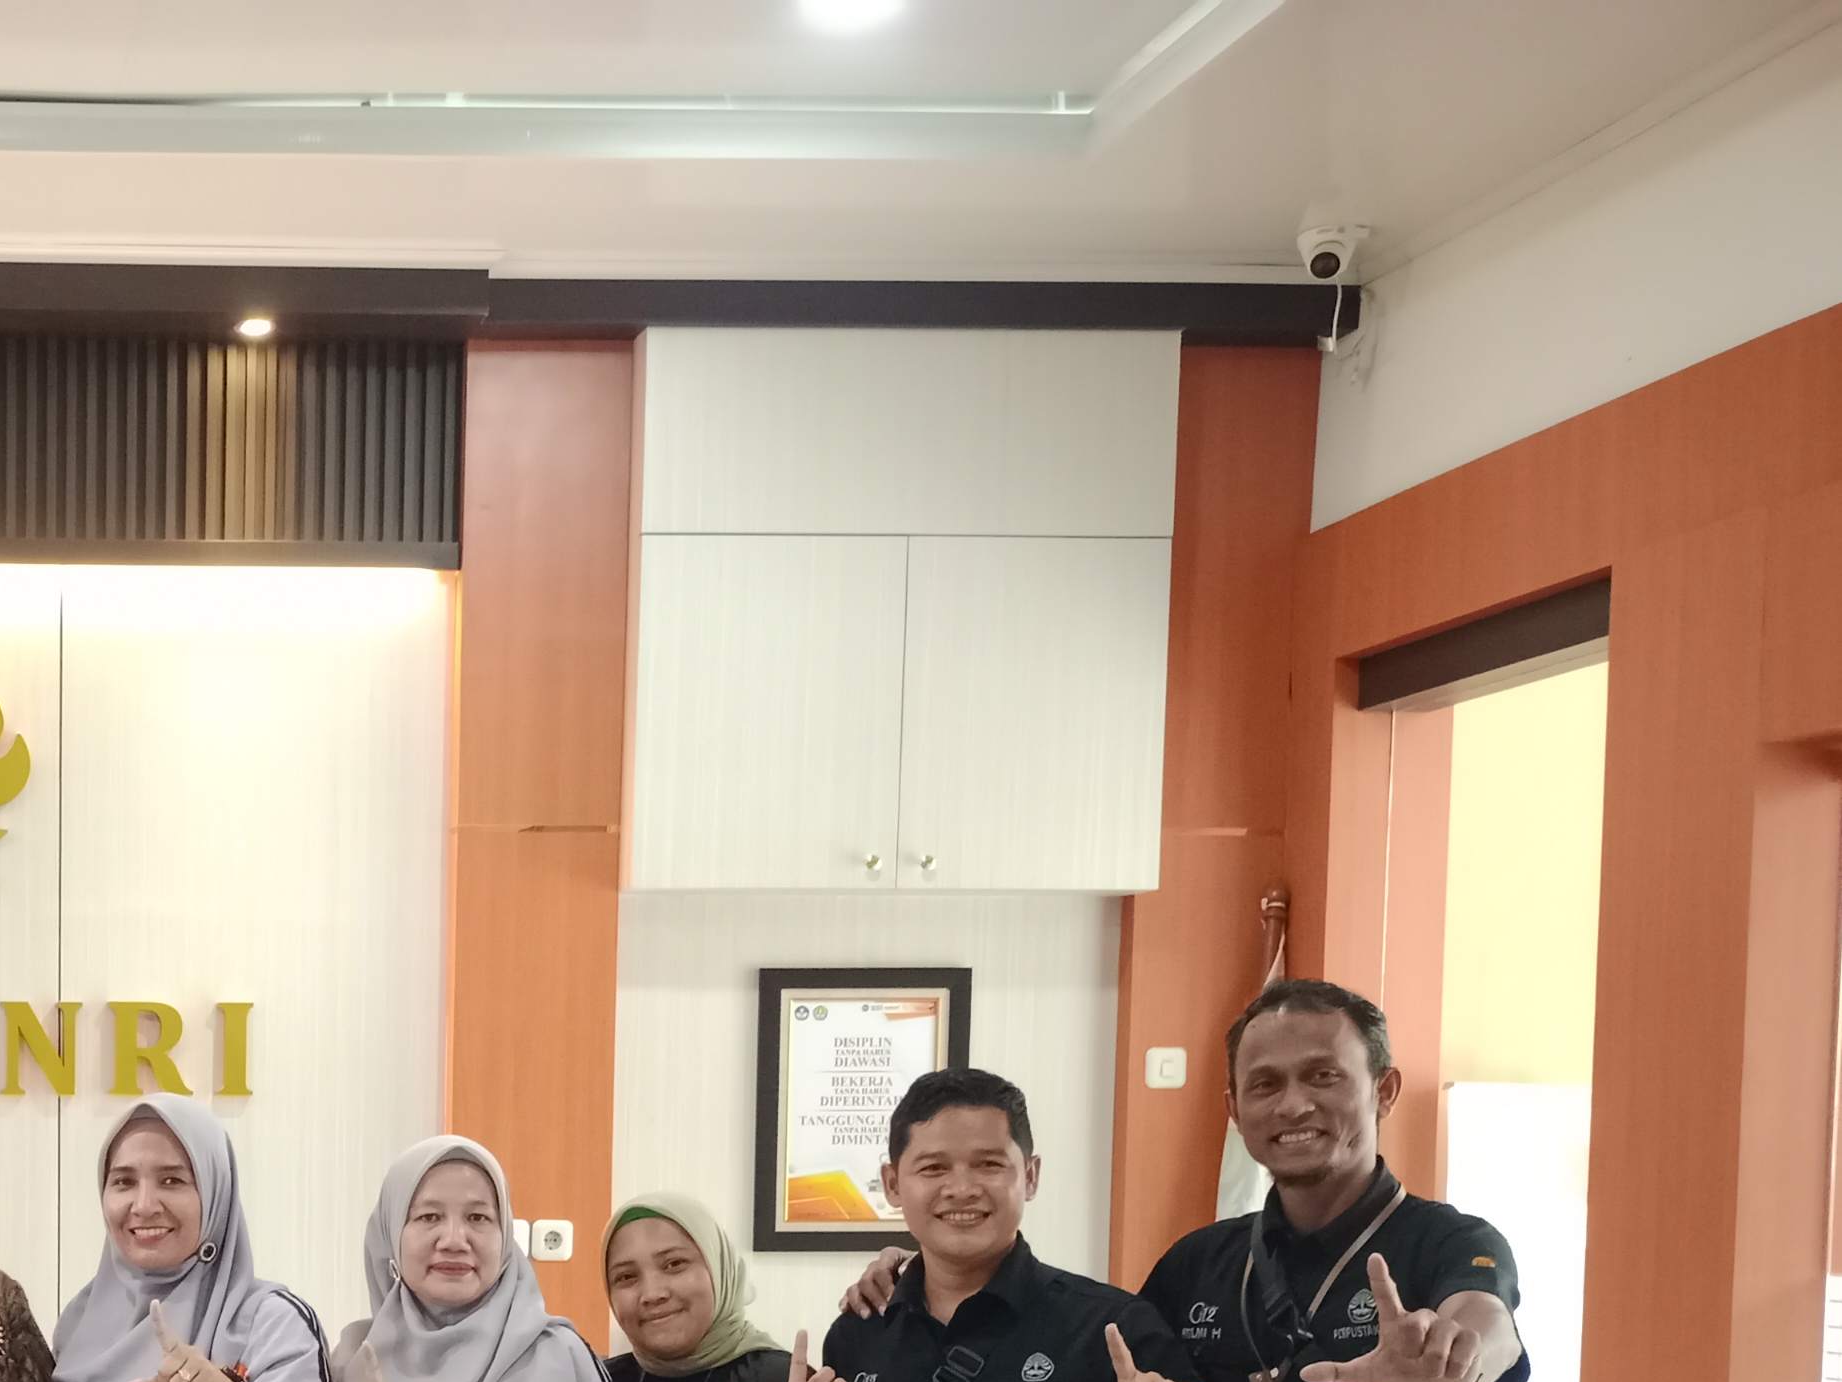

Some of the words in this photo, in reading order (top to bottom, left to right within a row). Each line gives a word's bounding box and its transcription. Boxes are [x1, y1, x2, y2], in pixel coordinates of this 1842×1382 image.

[833, 1036, 893, 1048] DISIPLIN
[834, 1057, 892, 1068] DIAWASI
[831, 1076, 894, 1087] BEKERJA
[799, 1115, 875, 1127] TANGGUNG
